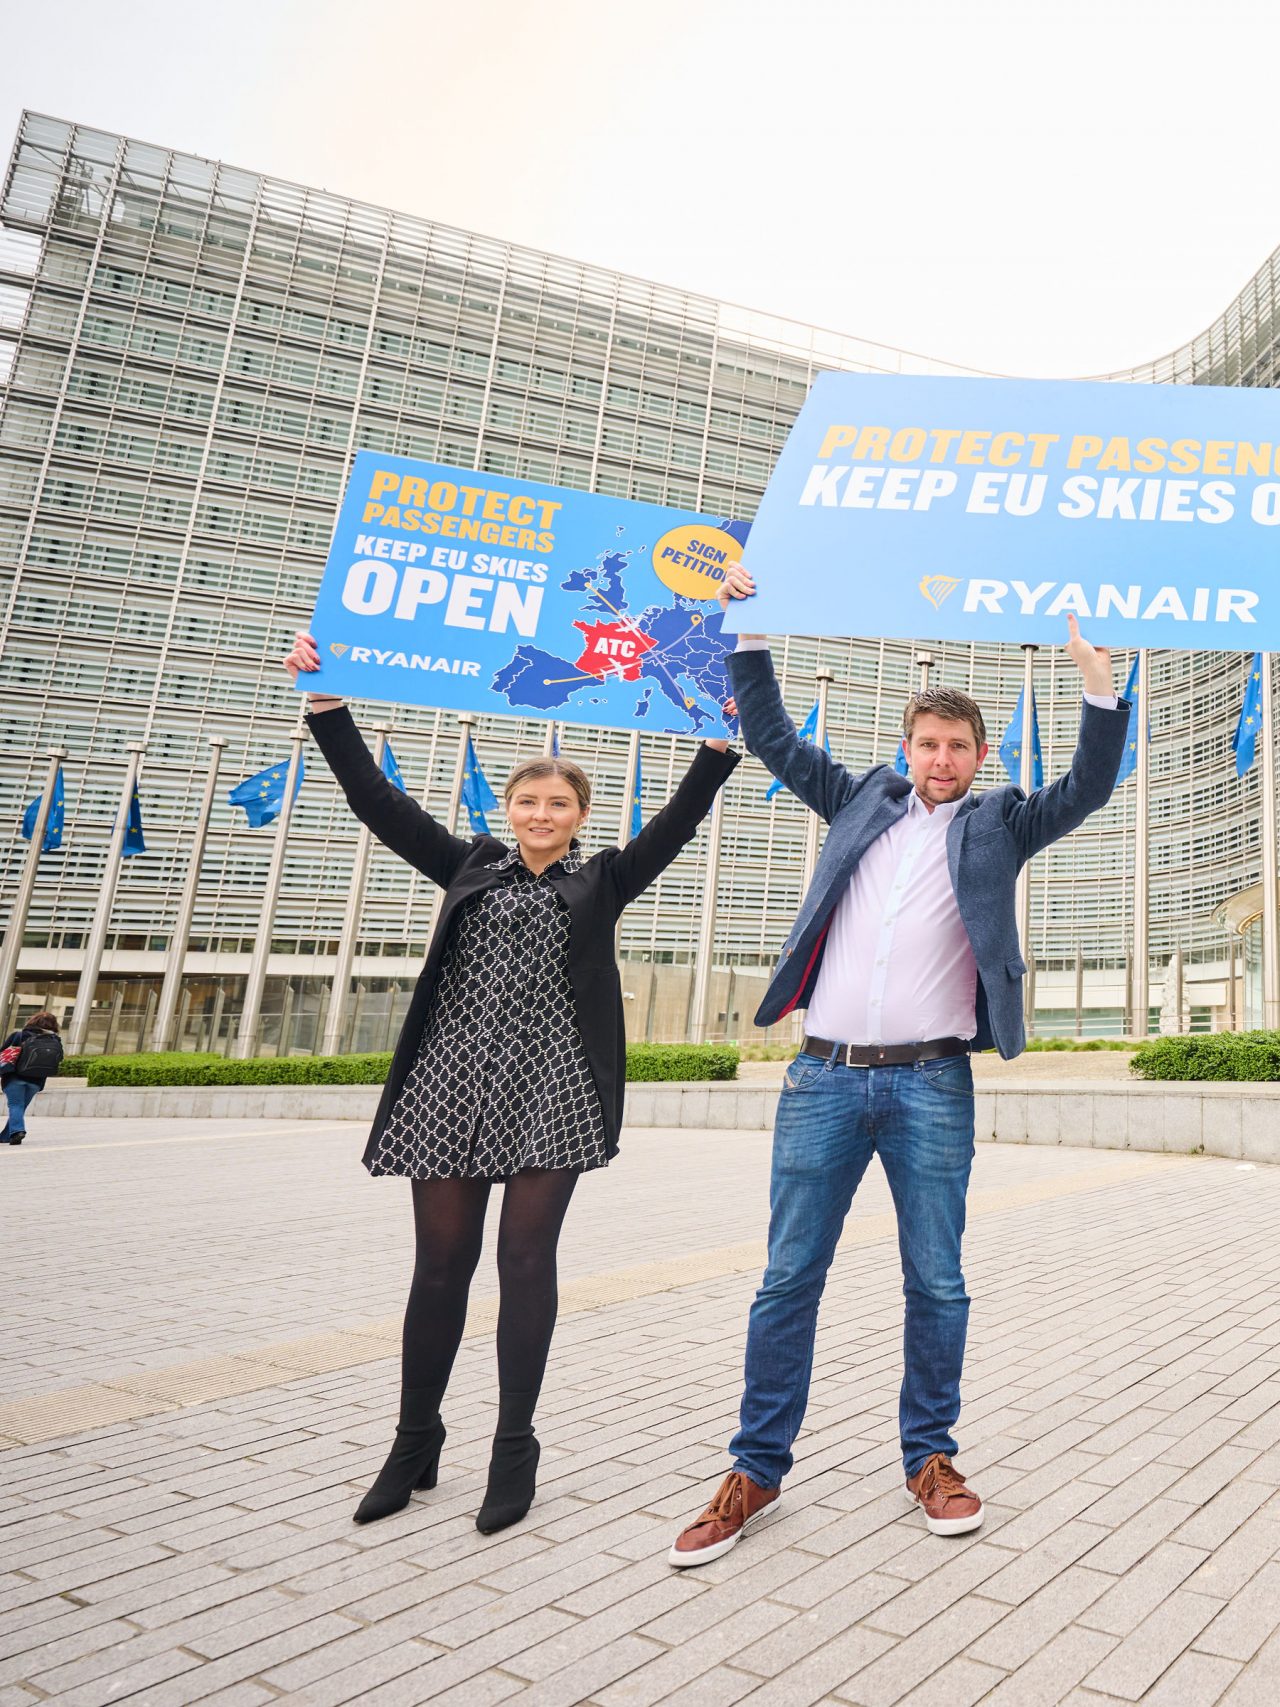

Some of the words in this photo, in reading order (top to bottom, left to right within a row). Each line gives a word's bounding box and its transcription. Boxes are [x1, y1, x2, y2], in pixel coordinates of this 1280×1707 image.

[817, 425, 1059, 468] PROTECT
[368, 470, 562, 530] PROTECT
[799, 466, 956, 512] KEEP
[966, 472, 1051, 517] EU
[1058, 476, 1236, 524] SKIES
[361, 502, 556, 553] PASSENGERS
[353, 533, 428, 564] KEEP
[431, 545, 468, 571] EU
[471, 552, 549, 583] SKIES
[687, 540, 727, 564] SIGN
[341, 559, 545, 637] OPEN
[962, 578, 1260, 623] RYANAIR
[350, 648, 481, 677] RYANAIR
[594, 637, 636, 658] ATC
